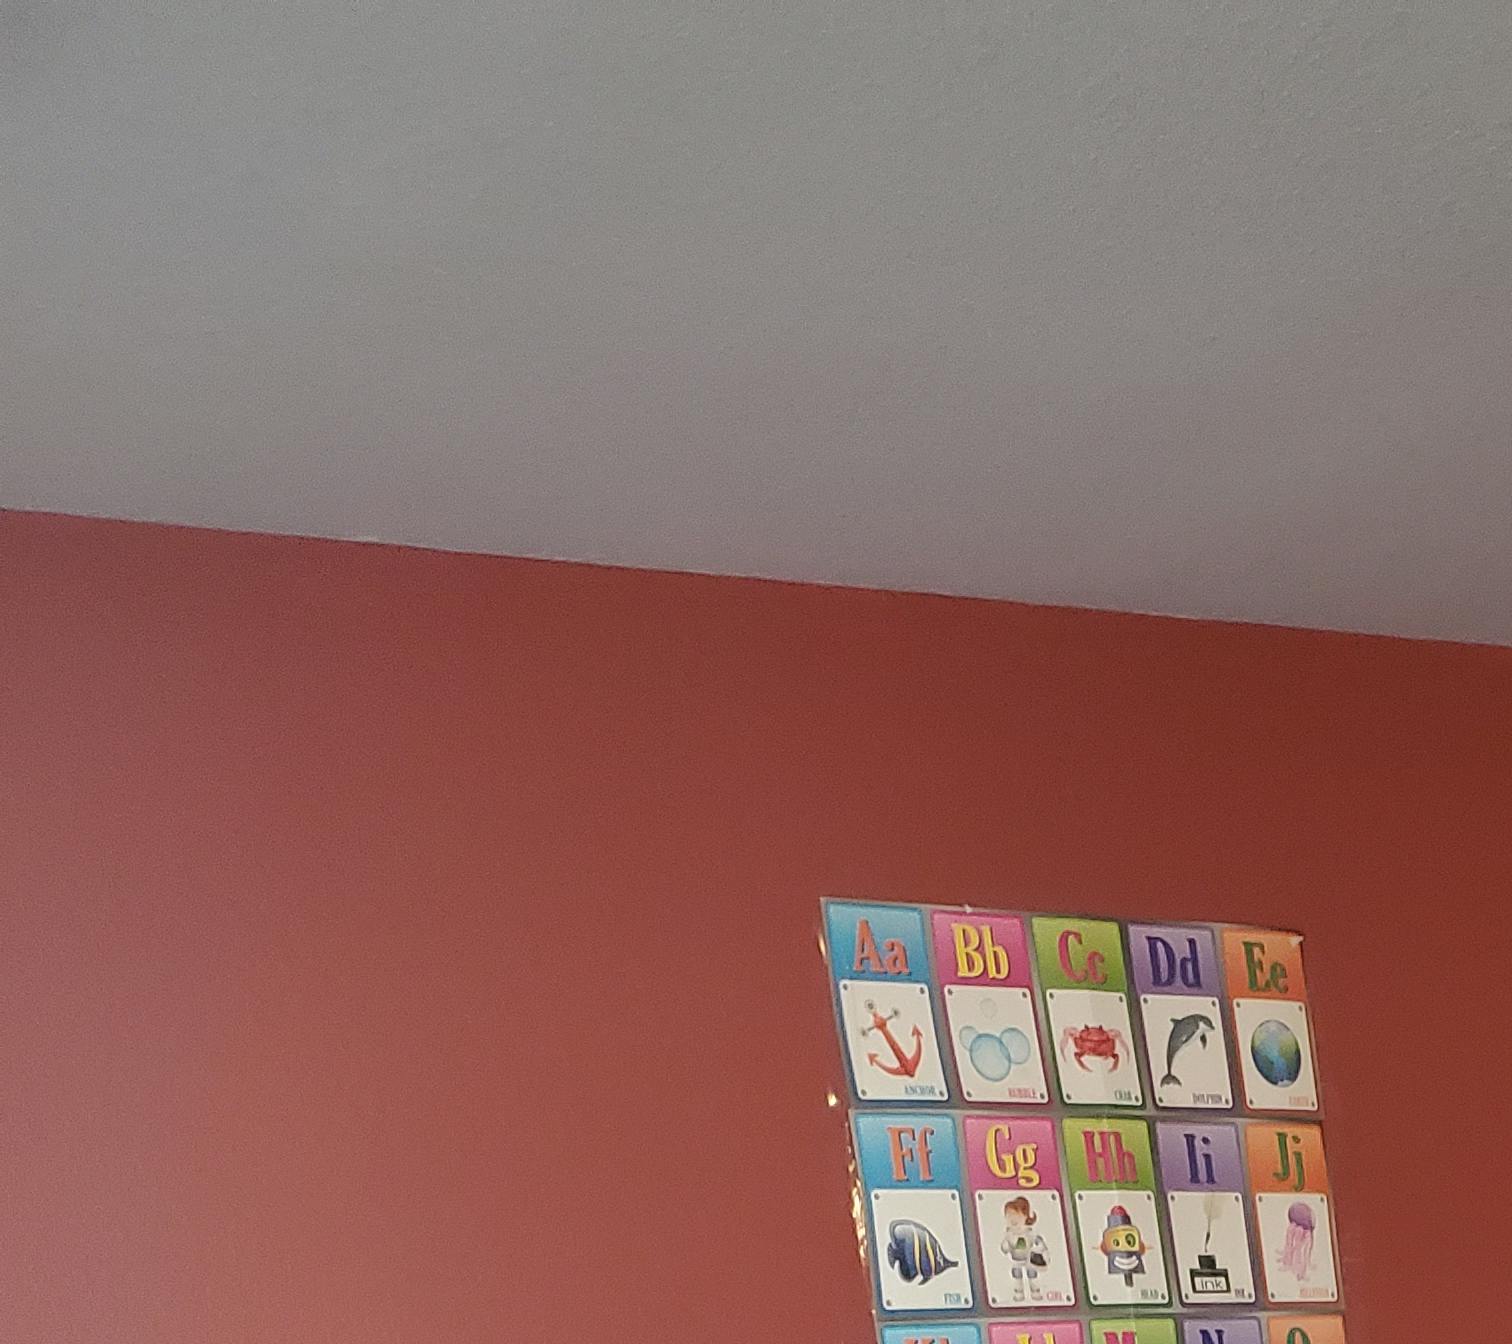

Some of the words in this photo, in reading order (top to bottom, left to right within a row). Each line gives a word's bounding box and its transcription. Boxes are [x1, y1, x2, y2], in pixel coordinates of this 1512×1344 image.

[852, 917, 911, 976] Aa
[951, 922, 1010, 980] Bb
[1057, 929, 1108, 984] Cc
[1145, 936, 1203, 989] Dd
[1242, 941, 1289, 993] Ee
[887, 1126, 935, 1181] Ff
[985, 1124, 1040, 1188] Gg
[1082, 1131, 1139, 1184] Hh
[1184, 1133, 1217, 1184] Ii
[1272, 1131, 1306, 1191] Jj
[943, 1293, 961, 1305] FISH
[1199, 1279, 1223, 1291] ink
